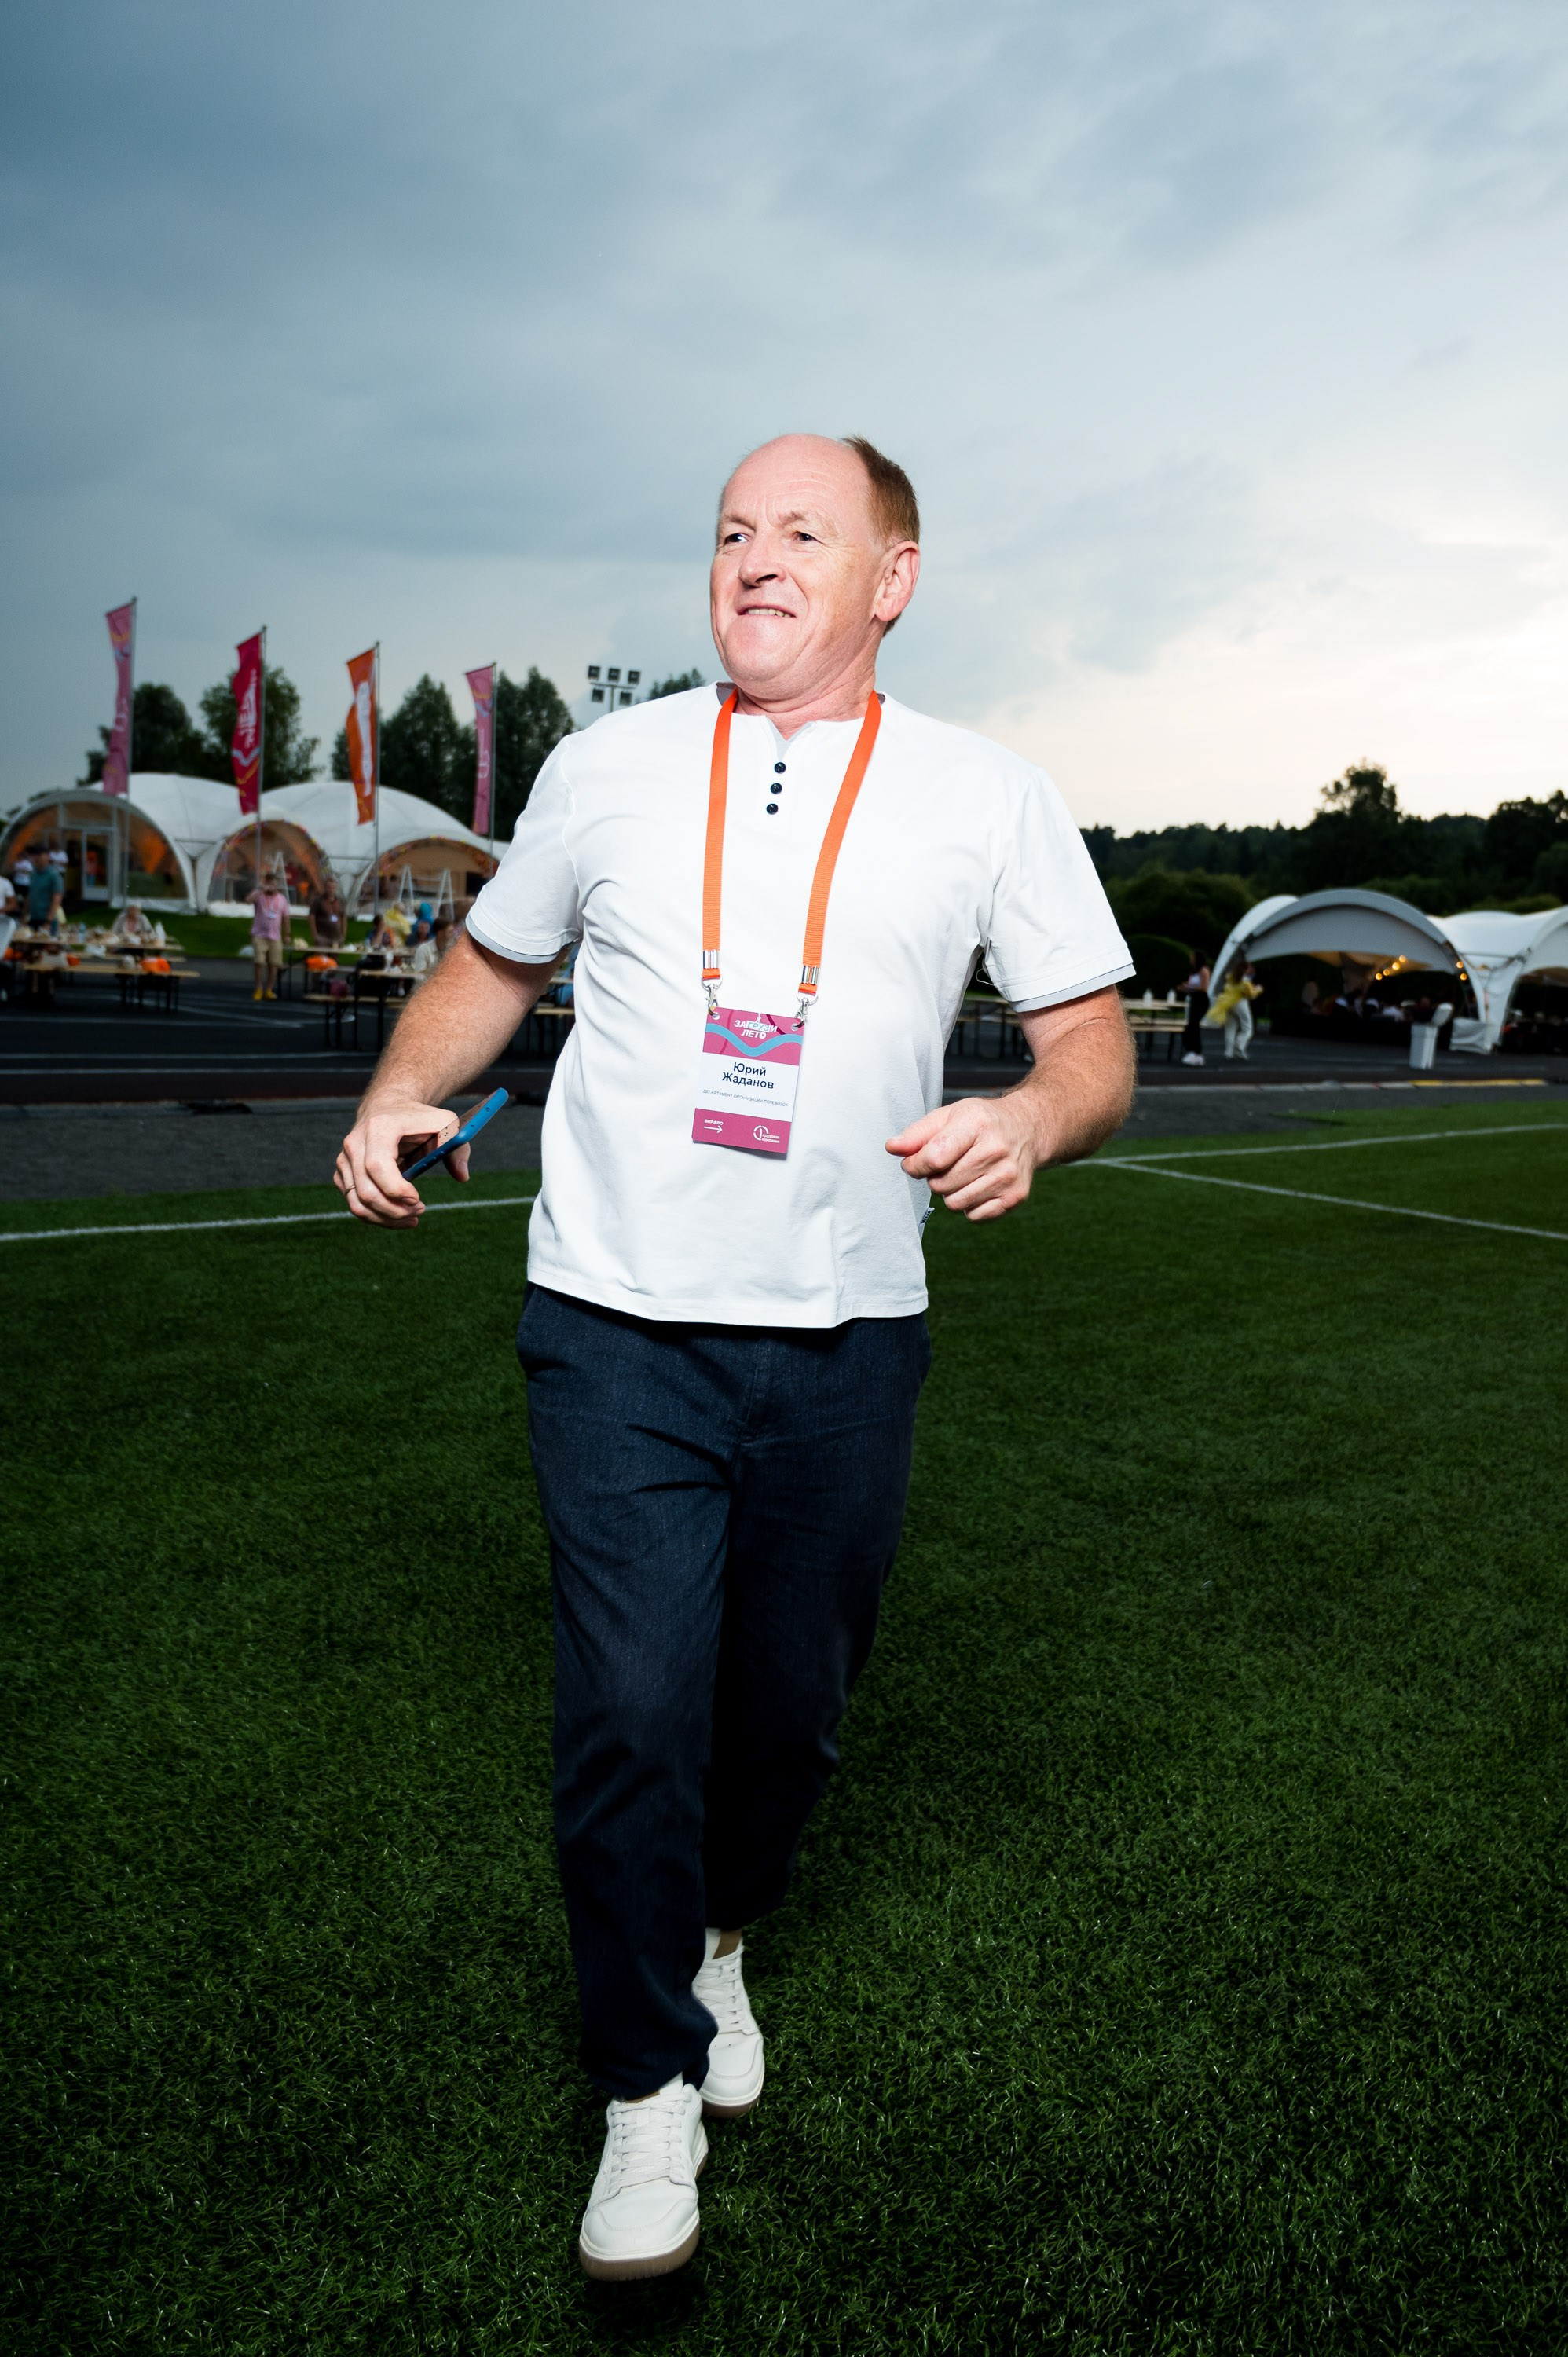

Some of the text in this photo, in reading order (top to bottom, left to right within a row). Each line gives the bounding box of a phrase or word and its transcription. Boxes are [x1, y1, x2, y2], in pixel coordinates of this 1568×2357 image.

[734, 1019, 778, 1033] ЗАГРУЗИ
[741, 1029, 767, 1039] ЛЕТО
[733, 1062, 767, 1076] Юрий
[722, 1072, 774, 1089] Жаданов
